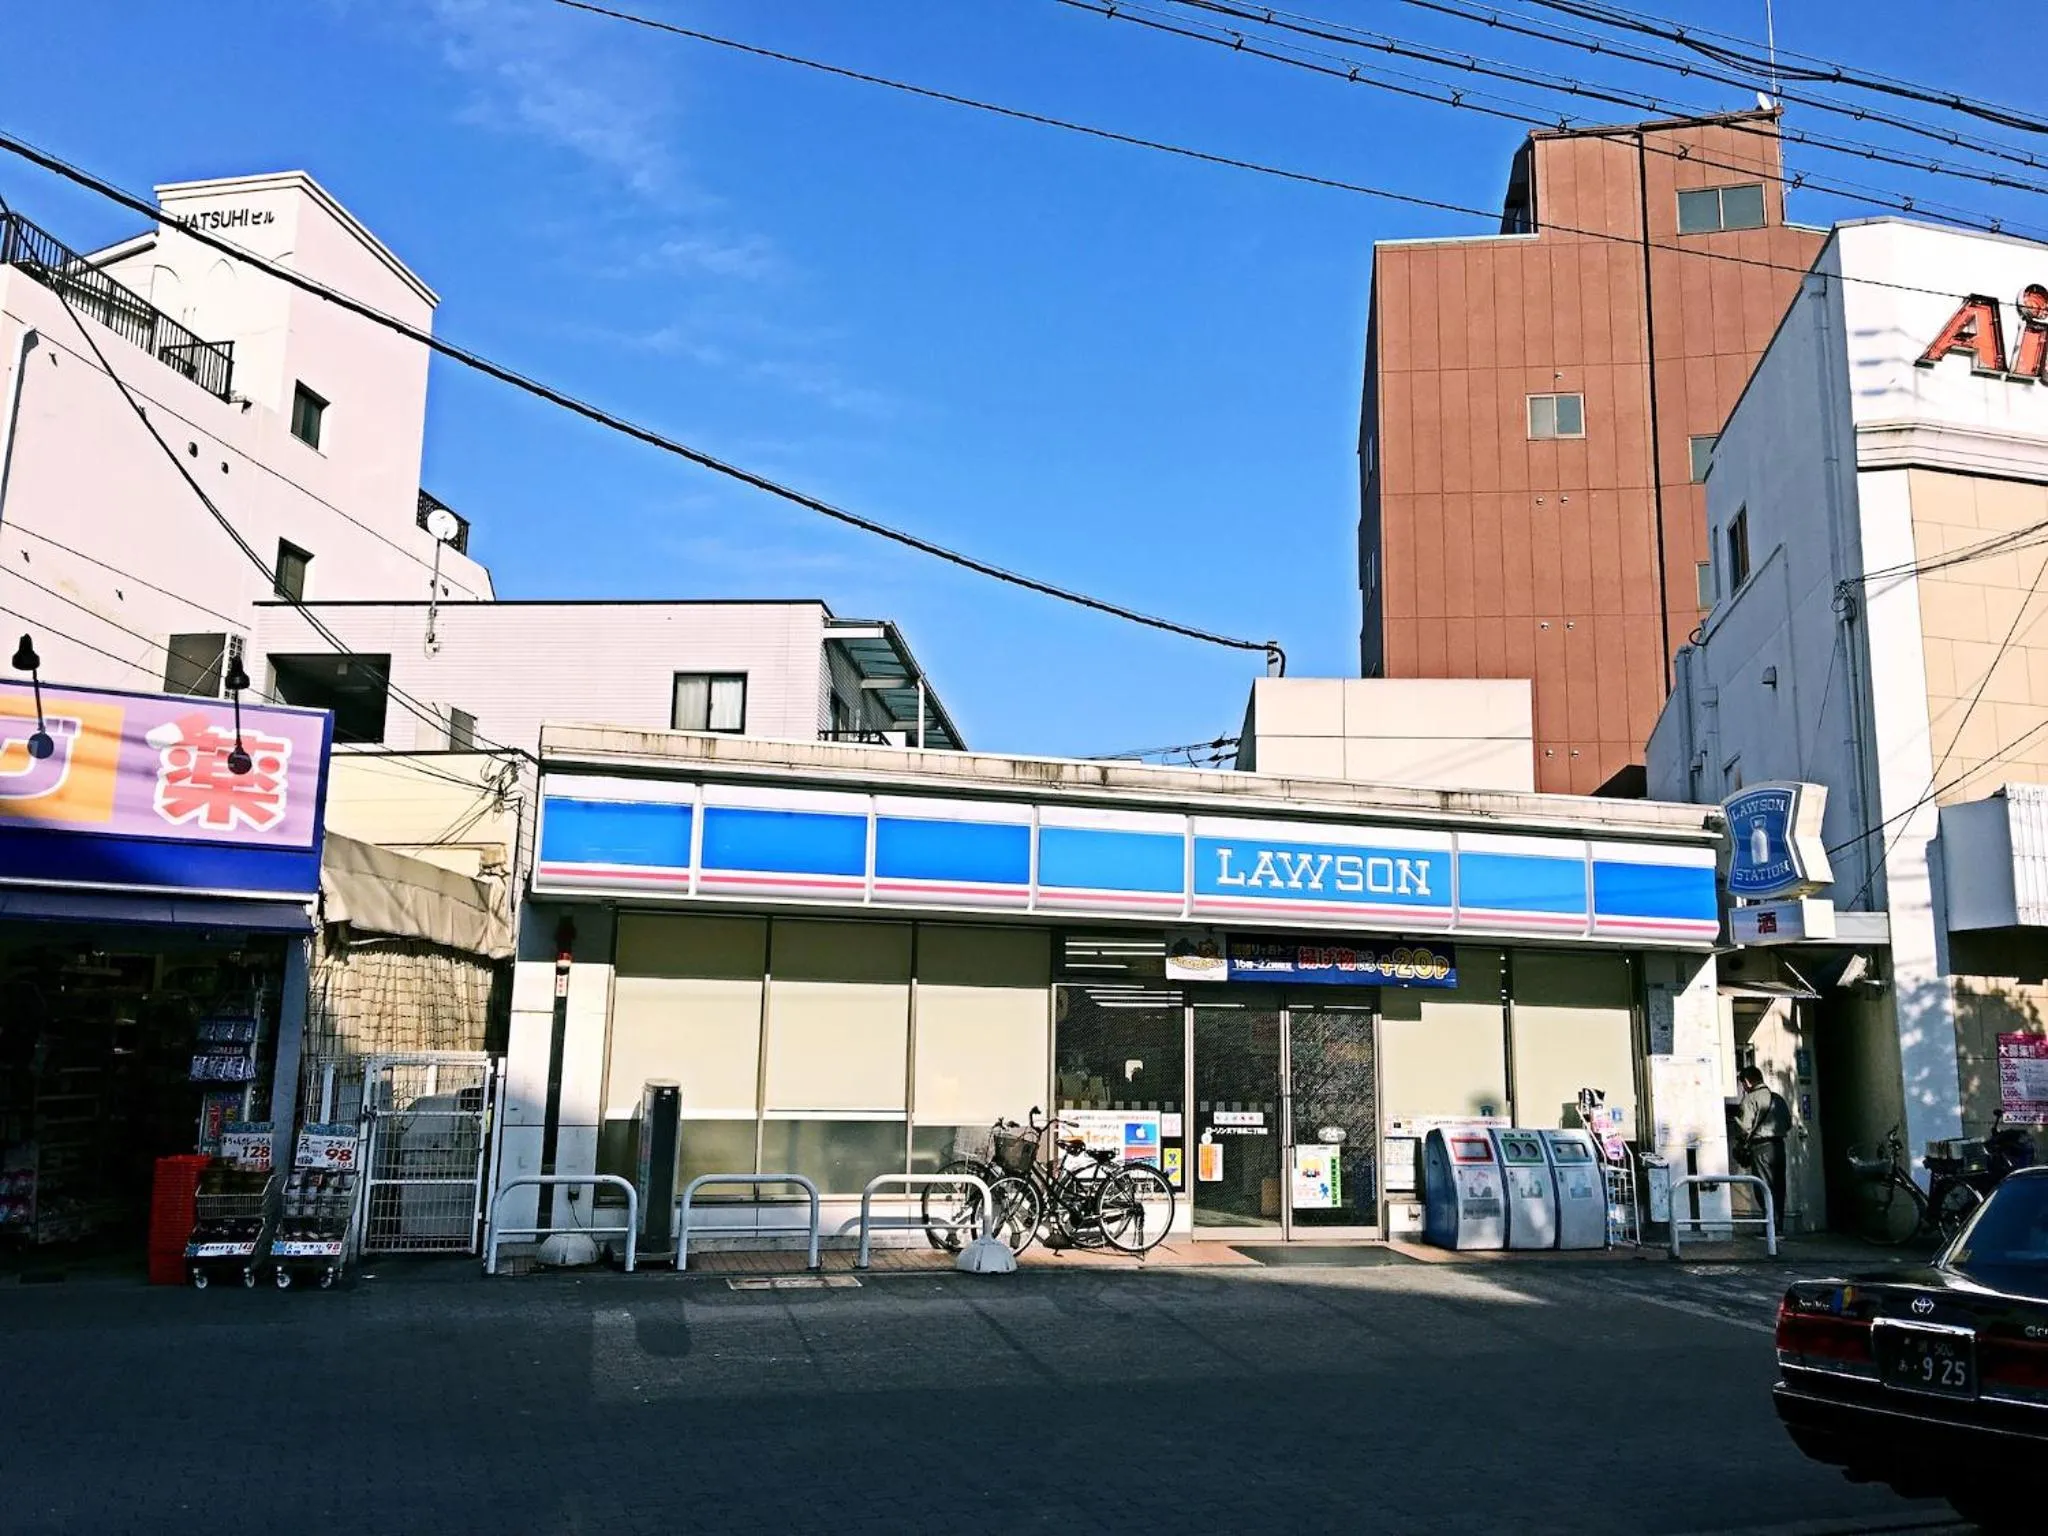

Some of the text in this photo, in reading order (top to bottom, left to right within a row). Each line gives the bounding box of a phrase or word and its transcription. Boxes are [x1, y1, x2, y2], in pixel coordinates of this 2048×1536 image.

[1913, 283, 2048, 387] Ai
[146, 714, 292, 832] 薬
[1732, 799, 1786, 821] LAWSON
[1216, 848, 1432, 896] LAWSON
[1735, 859, 1791, 881] STATION
[1757, 911, 1778, 934] 酒
[242, 1146, 271, 1158] 128
[325, 1149, 353, 1162] 98
